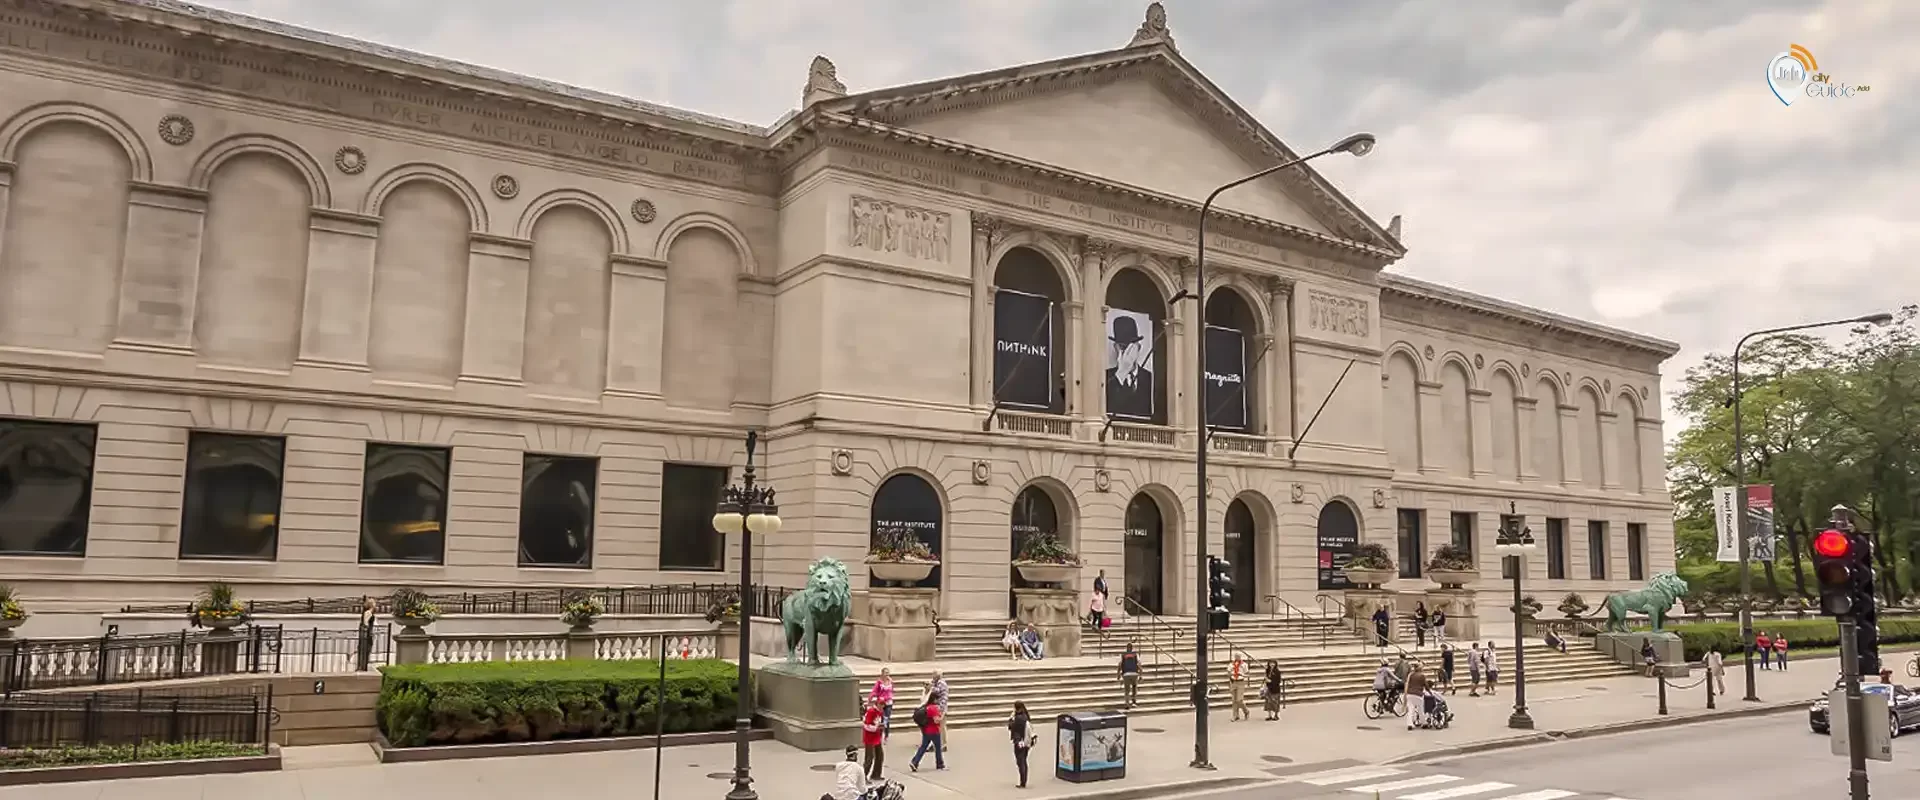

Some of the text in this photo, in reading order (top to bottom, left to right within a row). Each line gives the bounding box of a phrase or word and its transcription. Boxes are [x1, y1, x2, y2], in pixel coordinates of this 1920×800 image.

[471, 120, 559, 149] MICHAEL
[572, 139, 648, 166] ANGELO
[1024, 192, 1052, 210] THE
